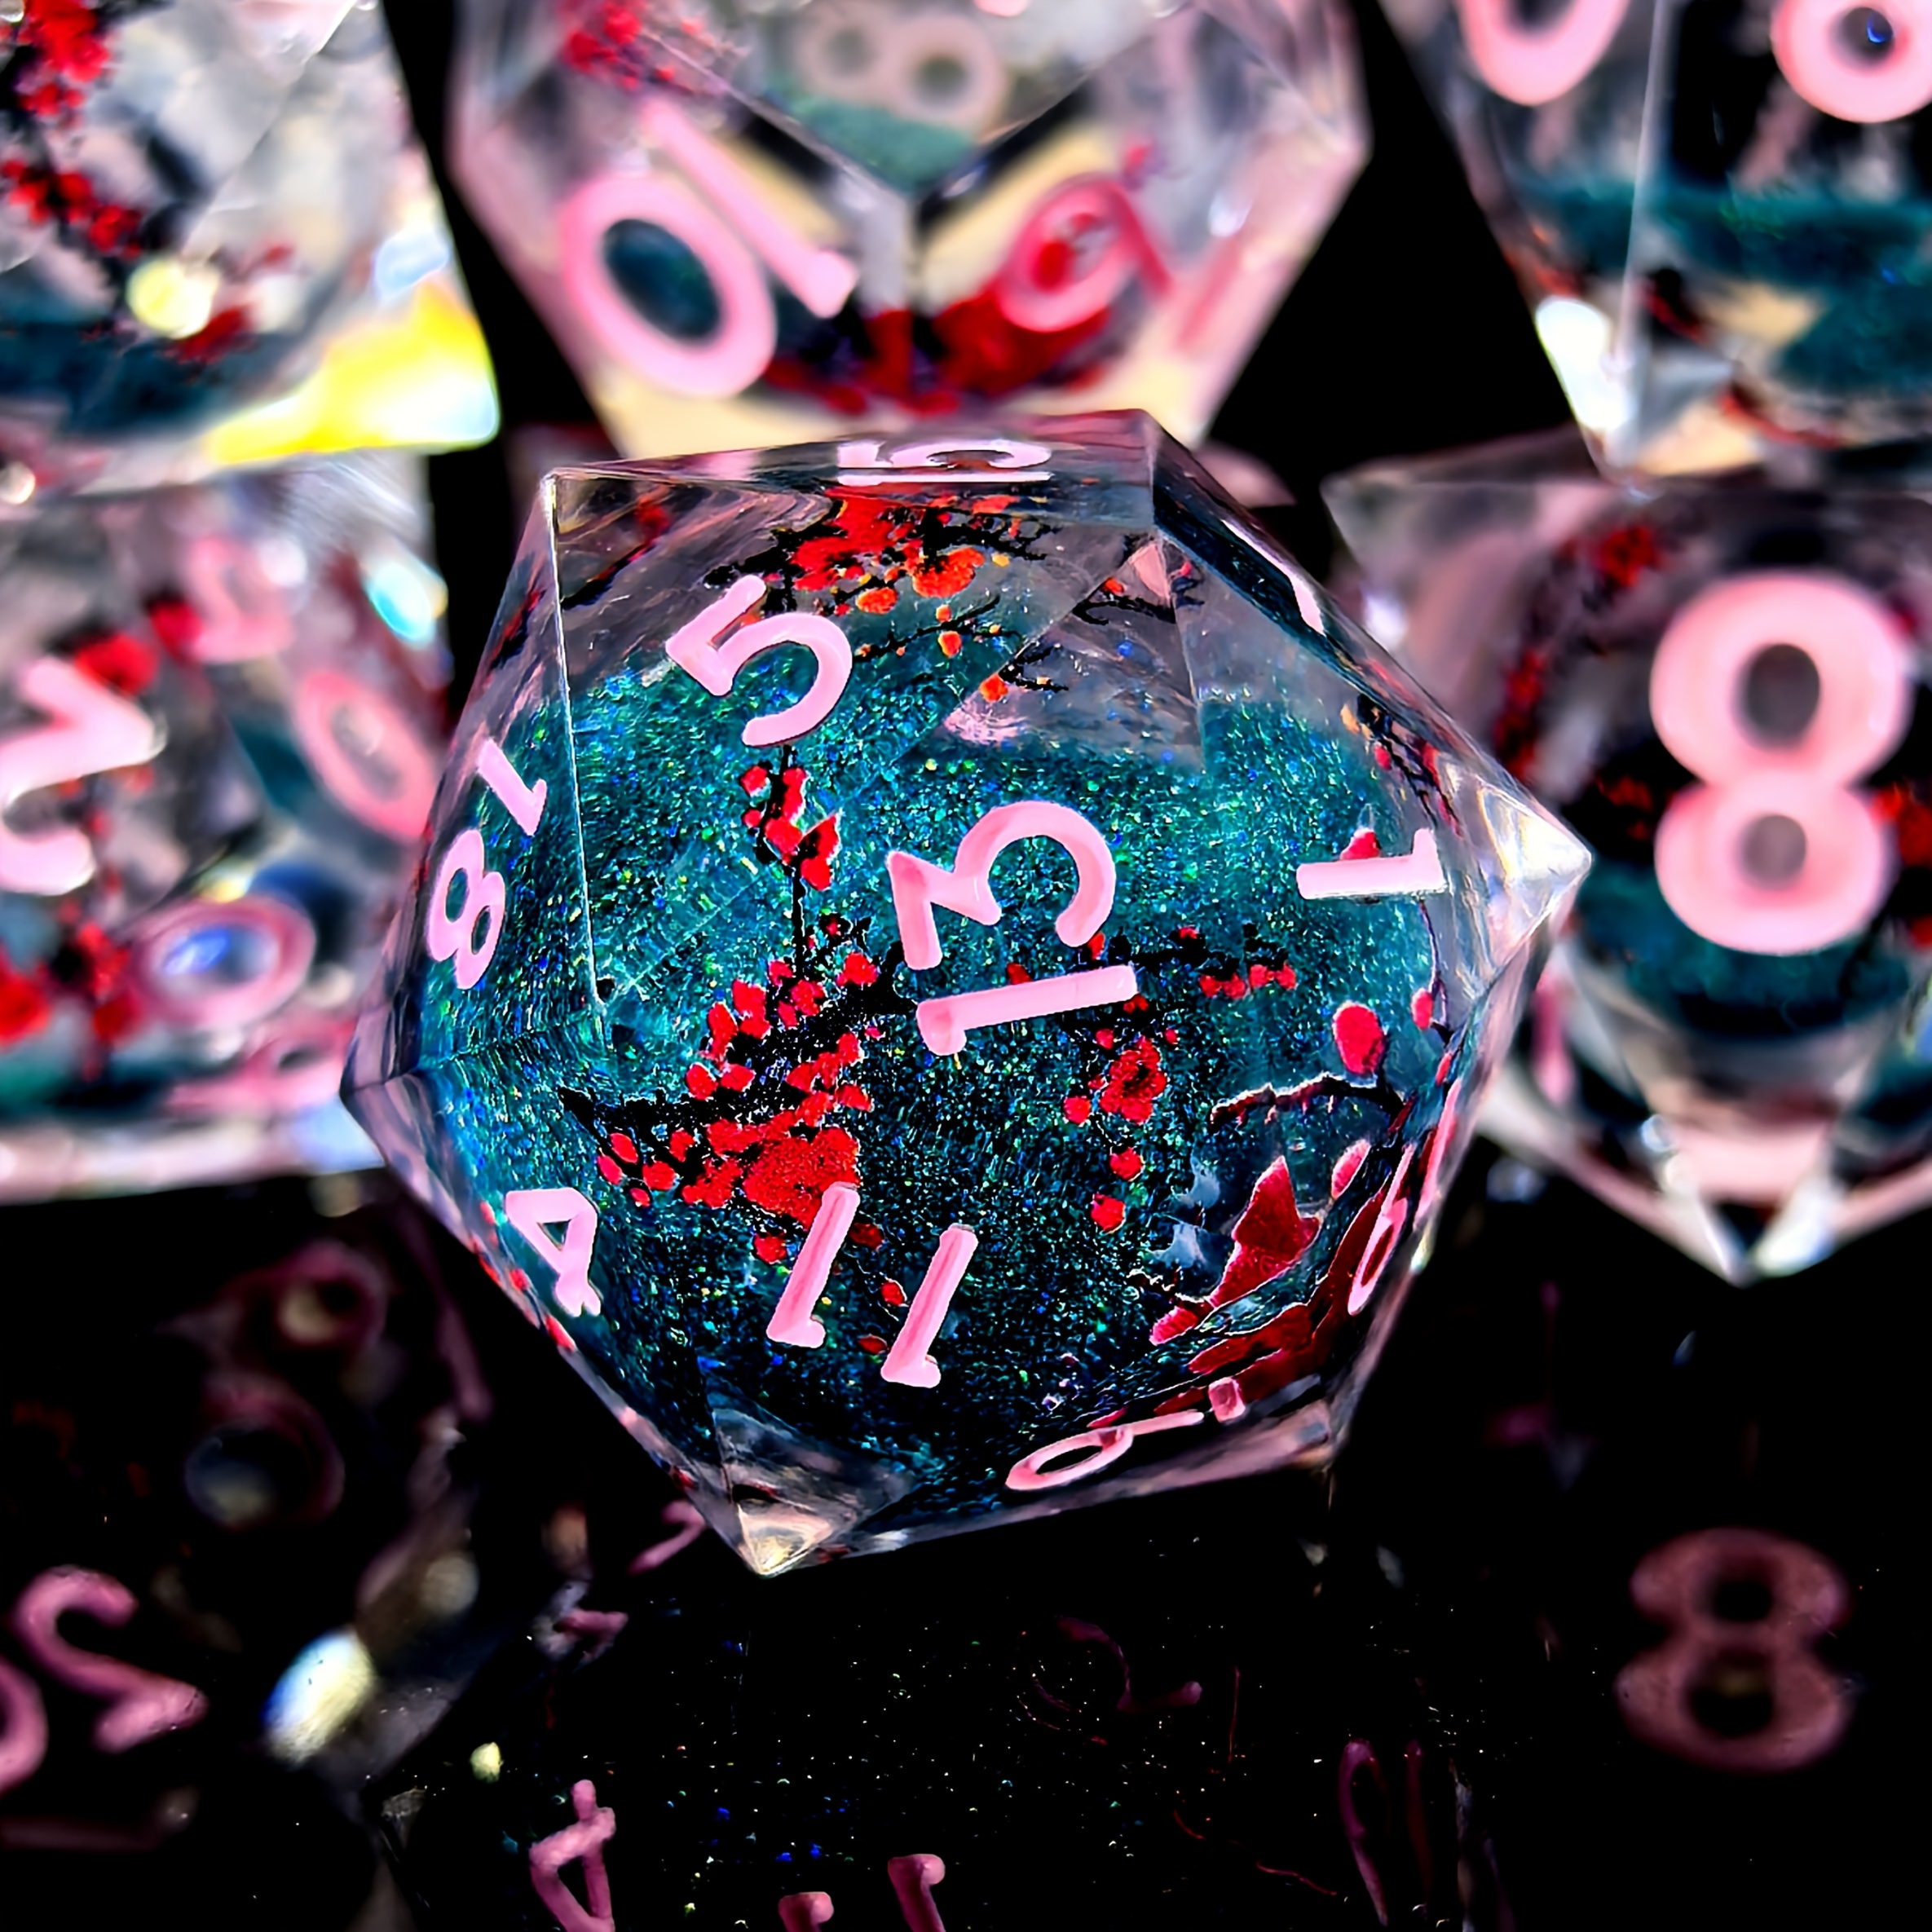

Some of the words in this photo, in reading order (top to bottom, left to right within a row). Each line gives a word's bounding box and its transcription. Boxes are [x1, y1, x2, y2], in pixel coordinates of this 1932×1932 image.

[664, 574, 854, 748] 5
[1648, 569, 1912, 955] 8
[428, 737, 548, 990] 18
[885, 801, 1138, 1056] 13
[1296, 827, 1446, 900] 1
[505, 1186, 602, 1317] 4
[766, 1181, 978, 1388] 11
